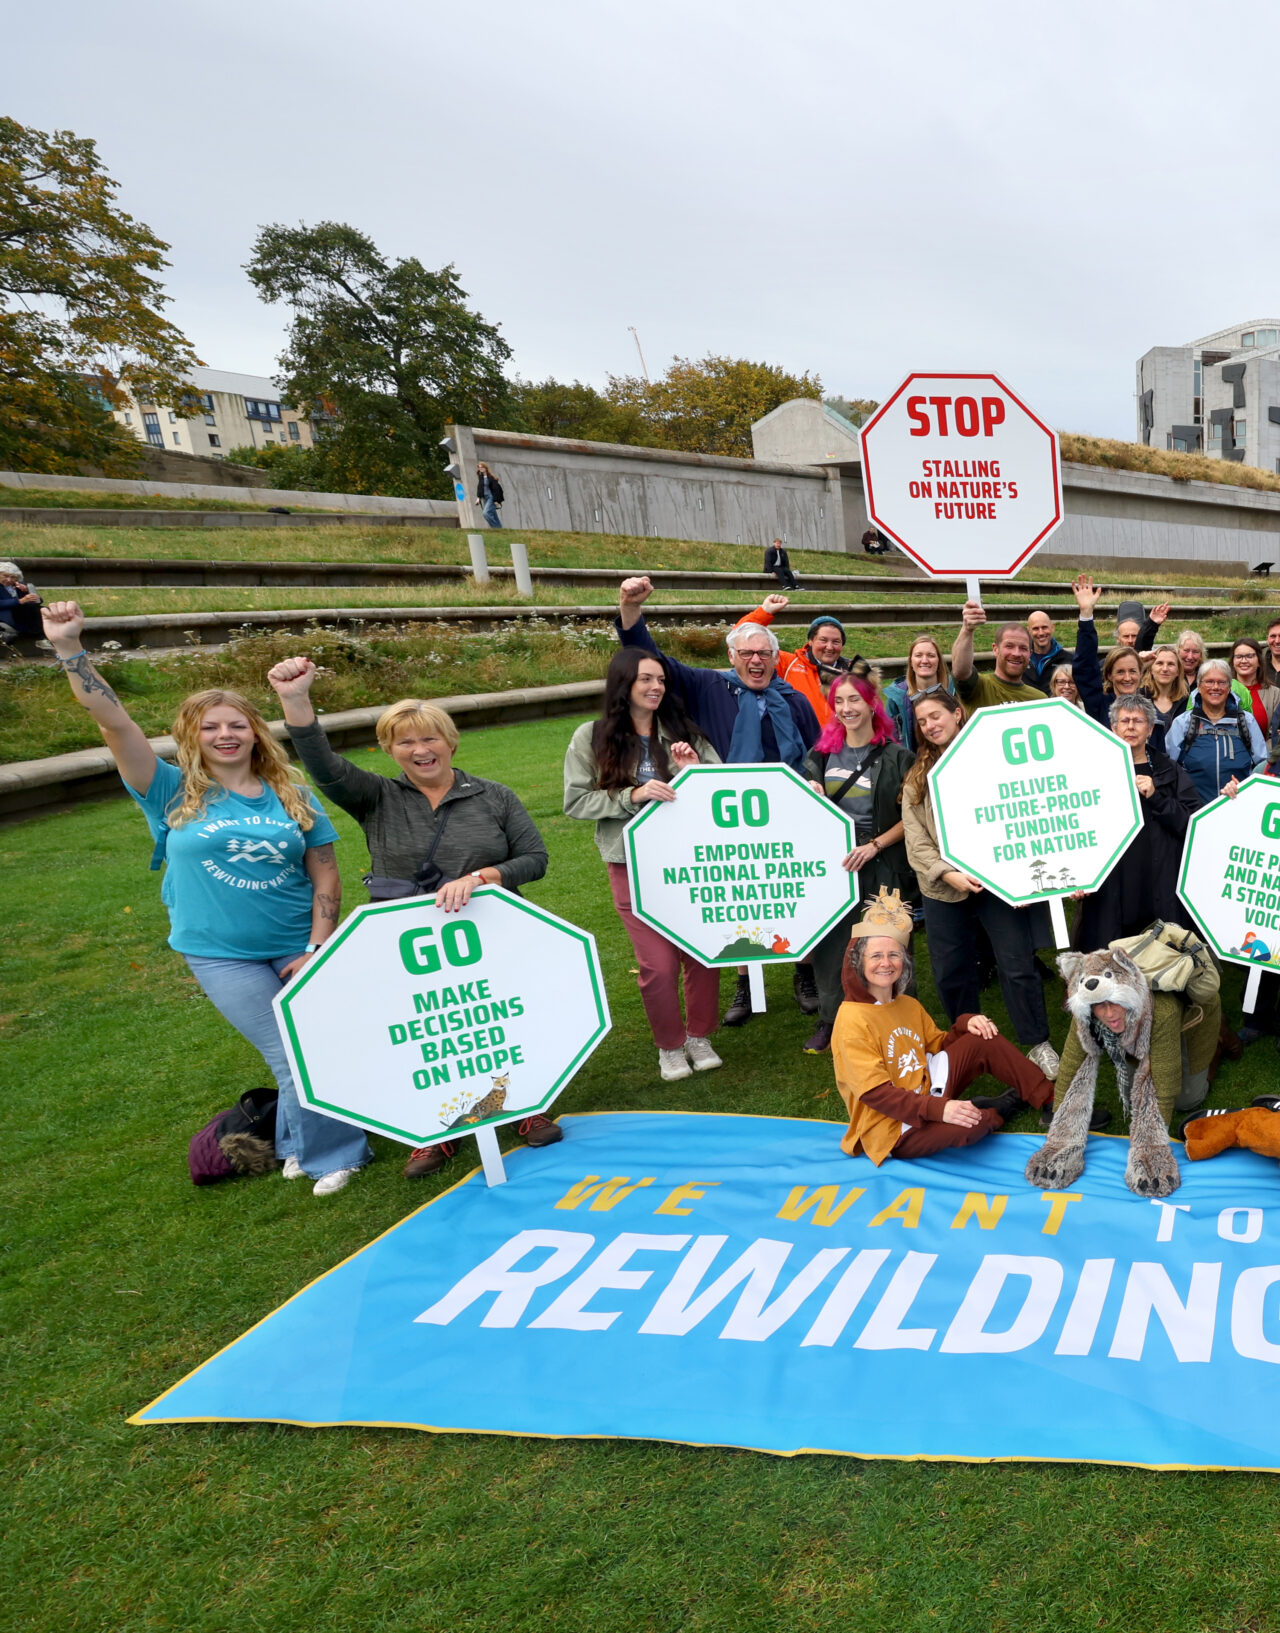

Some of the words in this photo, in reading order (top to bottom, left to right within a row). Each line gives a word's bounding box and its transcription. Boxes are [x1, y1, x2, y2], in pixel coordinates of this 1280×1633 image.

[906, 395, 1006, 438] STOP
[922, 459, 1001, 478] STALLING
[909, 480, 933, 499] ON
[936, 481, 1018, 499] NATURE'S
[934, 501, 997, 520] FUTURE
[1002, 723, 1055, 766] GO
[998, 774, 1069, 800] DELIVER
[711, 788, 770, 829] GO
[976, 789, 1100, 823] FUTURE-PROOF
[203, 818, 241, 833] WANT
[244, 815, 261, 825] TO
[1005, 812, 1080, 841] FUNDING
[694, 841, 794, 863] EMPOWER
[993, 842, 1027, 863] FOR
[1030, 830, 1097, 857] NATURE
[1229, 845, 1265, 868] GIVE
[200, 859, 269, 890] REWILDING
[663, 863, 761, 885] NATIONAL
[765, 860, 827, 880] PARKS
[1223, 864, 1259, 886] AND
[689, 885, 726, 904] FOR
[731, 881, 806, 902] NATURE
[1220, 881, 1233, 901] A
[701, 902, 798, 924] RECOVERY
[399, 919, 483, 976] GO
[412, 978, 493, 1014] MAKE
[388, 996, 524, 1046] DECISIONS
[420, 1025, 506, 1063] BASED
[412, 1063, 451, 1091] ON
[456, 1045, 525, 1079] HOPE
[555, 1176, 720, 1215] WE
[777, 1186, 1082, 1234] WANT
[1151, 1200, 1263, 1243] TO
